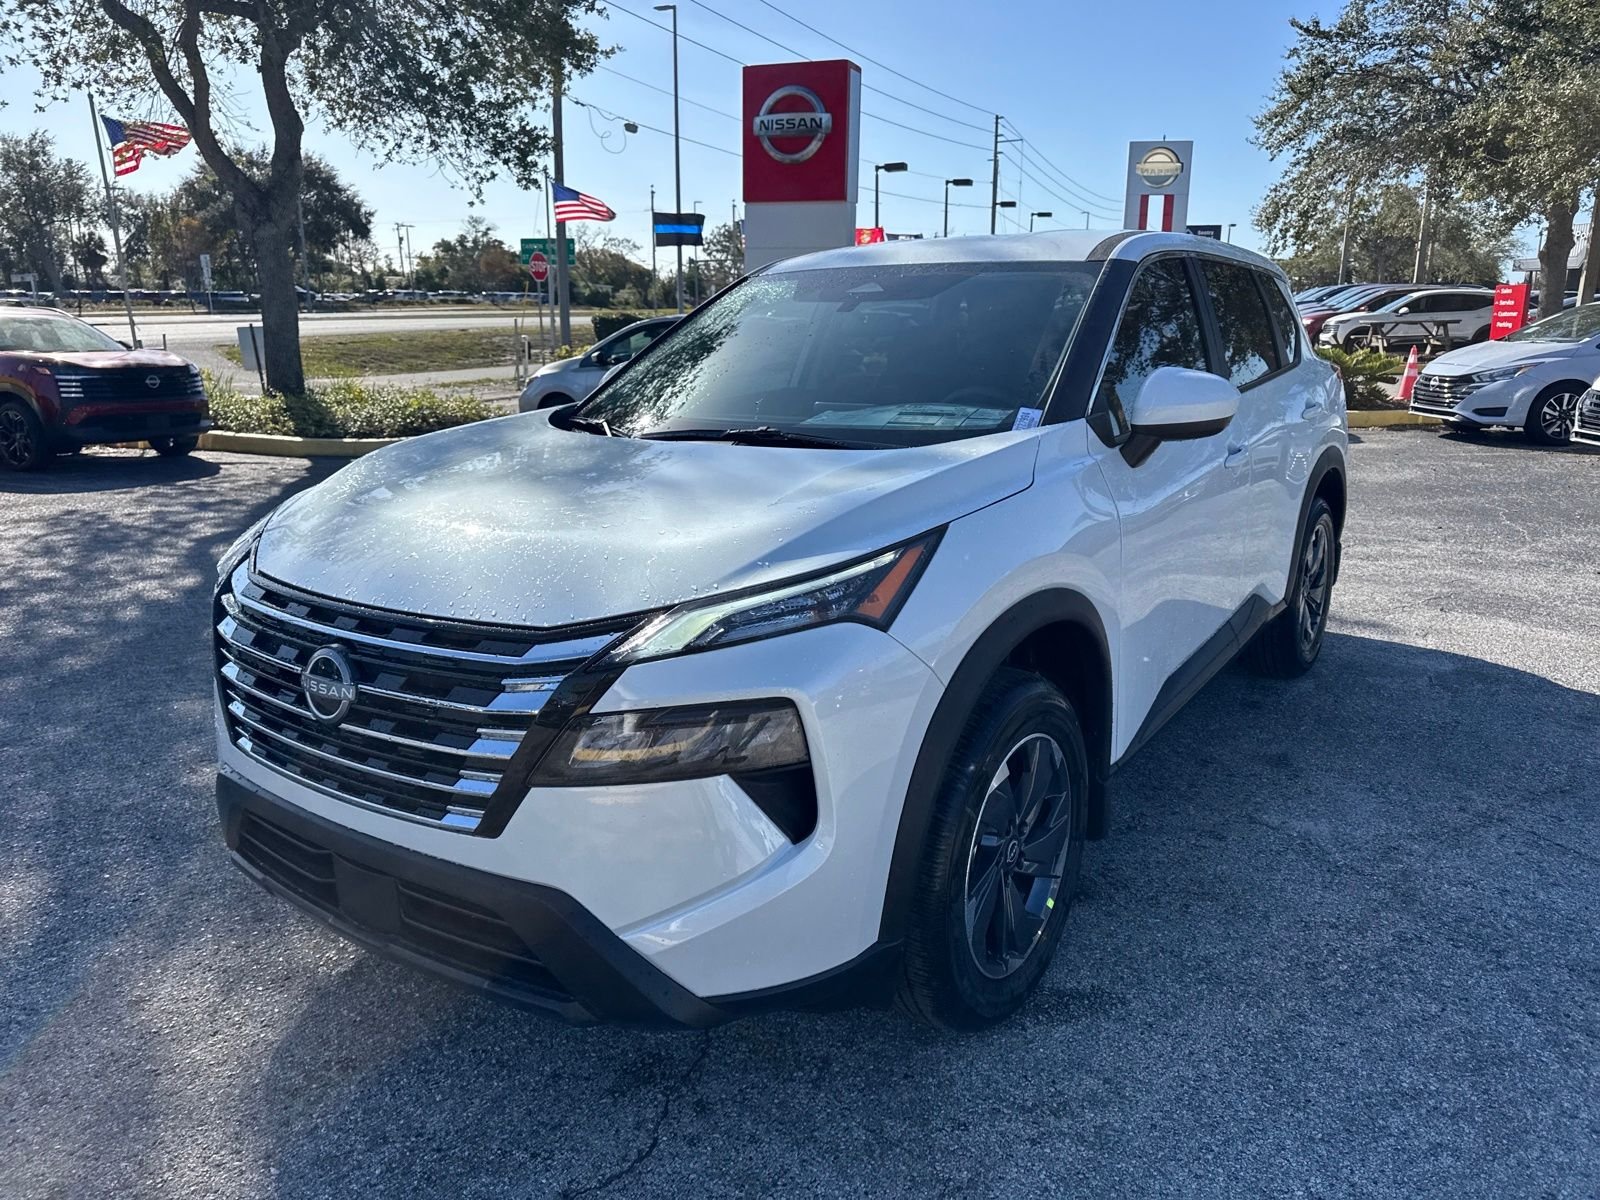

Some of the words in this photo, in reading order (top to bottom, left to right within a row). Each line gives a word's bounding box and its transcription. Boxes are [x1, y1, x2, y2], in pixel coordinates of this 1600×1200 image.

[759, 117, 823, 131] NISSAN
[530, 261, 547, 272] STOP
[302, 675, 353, 699] NISSAN
